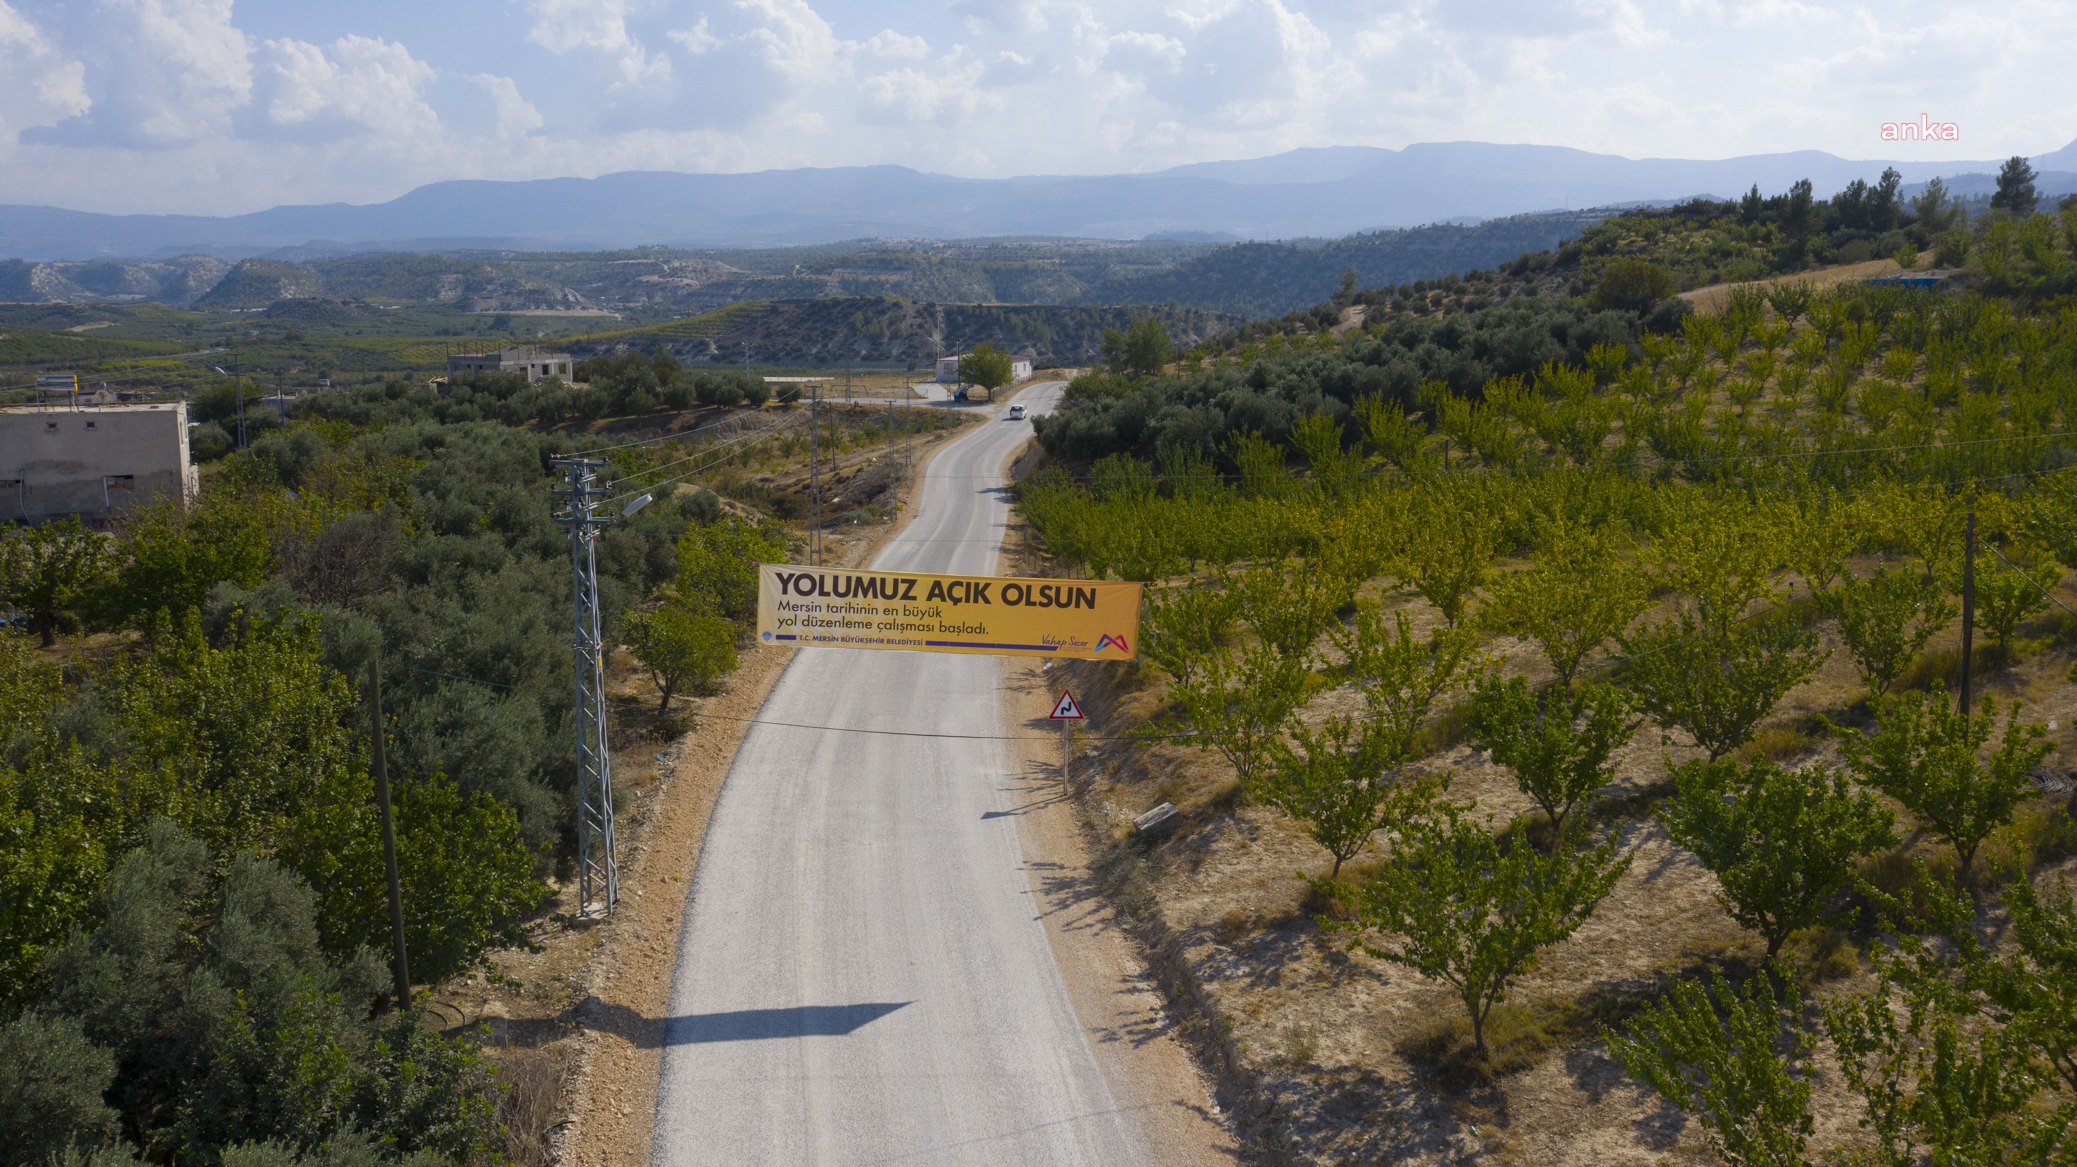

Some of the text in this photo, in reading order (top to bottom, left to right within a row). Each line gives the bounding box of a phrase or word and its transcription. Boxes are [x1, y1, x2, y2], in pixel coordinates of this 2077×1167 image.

[775, 572, 1096, 610] YOLUMUZ AÇIK OLSUN
[777, 599, 942, 620] Mersin tarihinin en büyük
[777, 613, 989, 636] yol düzenleme çalışması başladı.
[799, 634, 811, 642] T.C.
[812, 635, 839, 643] MERSİN
[1041, 633, 1067, 650] Vahap
